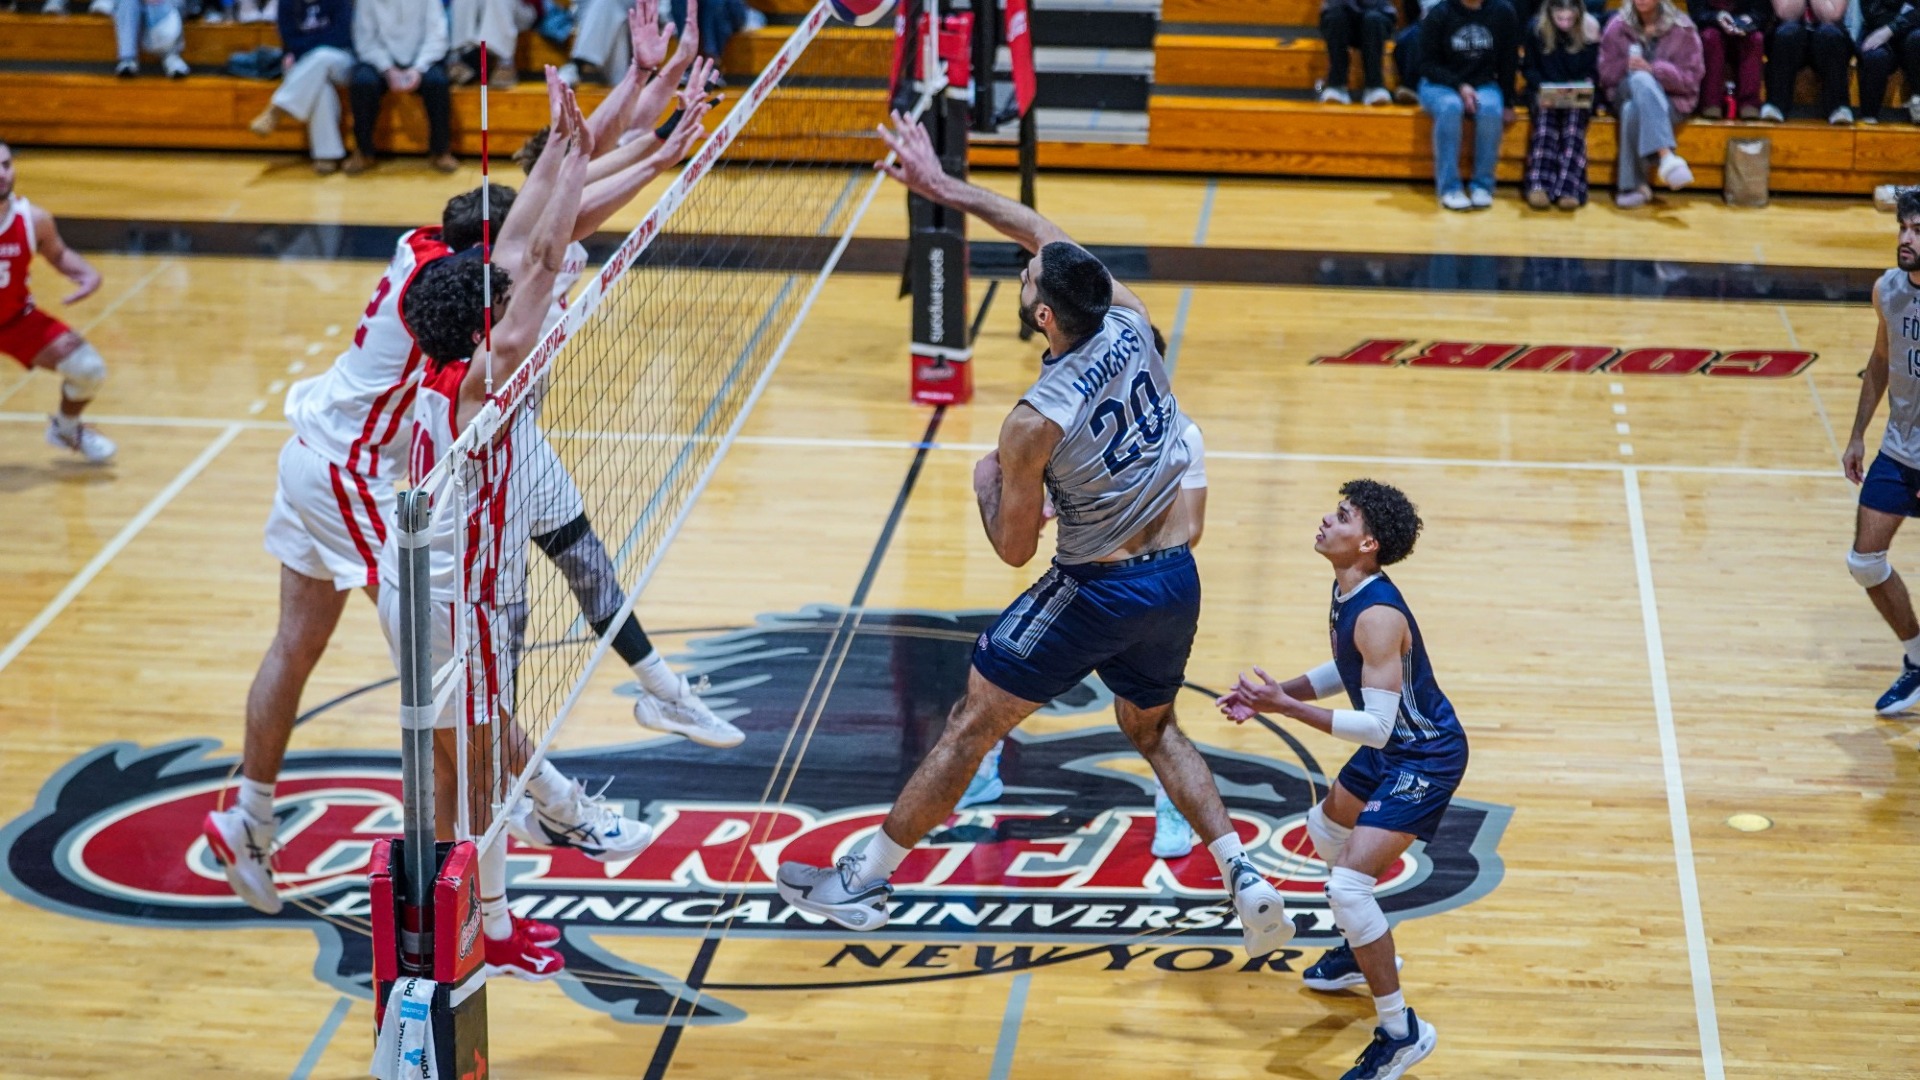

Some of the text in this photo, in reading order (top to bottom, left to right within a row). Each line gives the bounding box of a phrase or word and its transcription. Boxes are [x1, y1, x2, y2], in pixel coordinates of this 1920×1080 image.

[1308, 338, 1820, 379] COURT
[1088, 369, 1167, 479] 20
[822, 944, 1304, 974] NEW YOR
